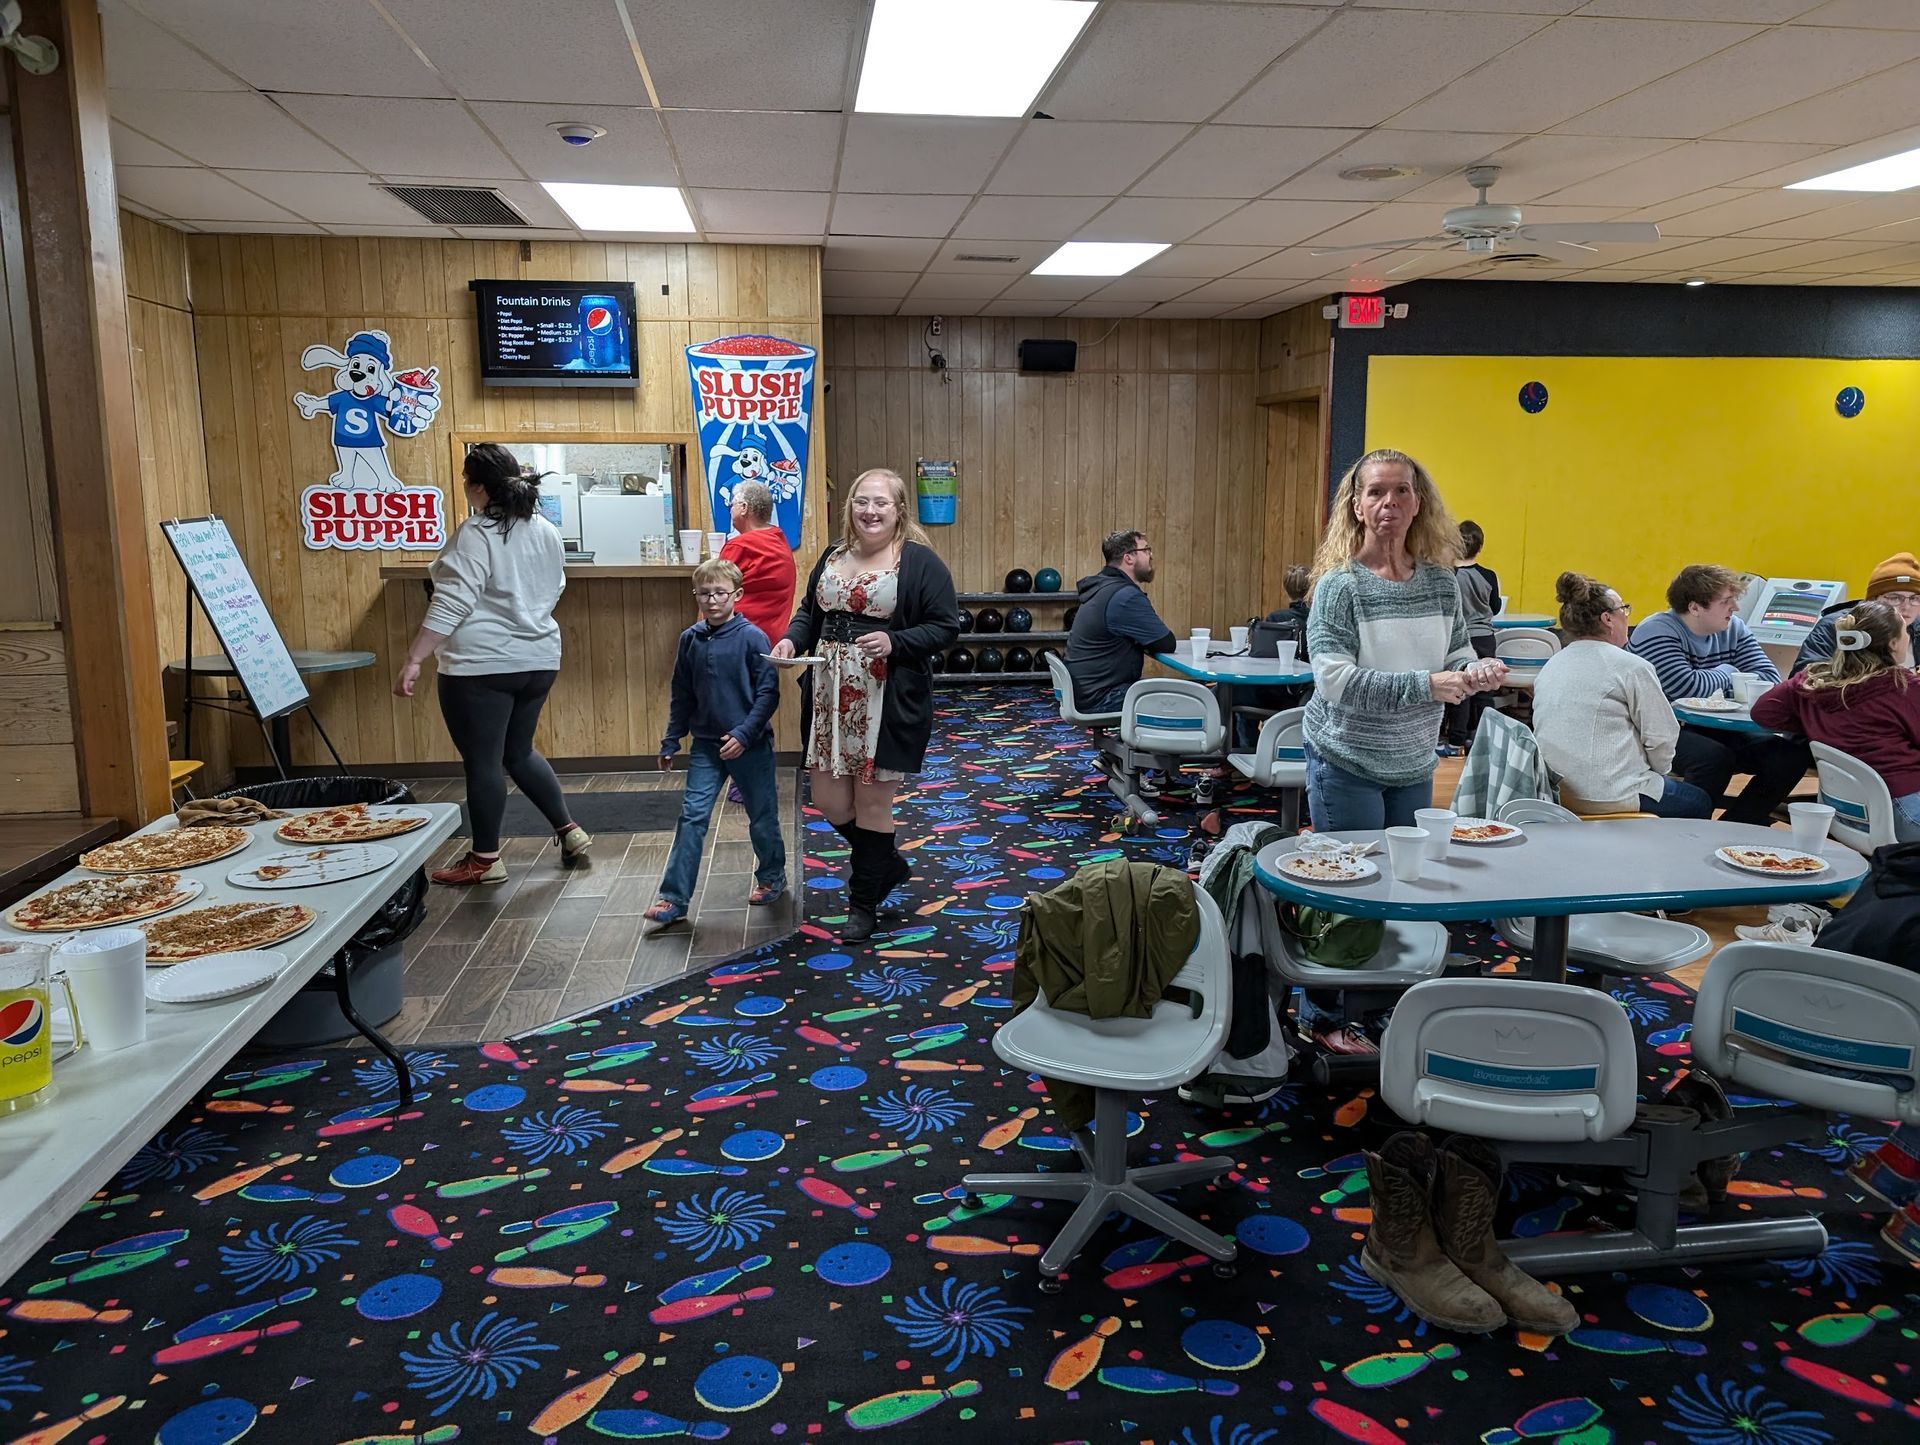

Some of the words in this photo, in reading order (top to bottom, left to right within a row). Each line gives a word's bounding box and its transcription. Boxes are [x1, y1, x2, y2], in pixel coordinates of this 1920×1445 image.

[496, 295, 539, 307] Fountain
[541, 295, 571, 307] Drinks
[1348, 298, 1379, 324] EXIT
[586, 335, 597, 366] pepsi
[699, 369, 803, 399] SLUSH
[344, 408, 369, 434] S
[309, 492, 437, 519] SLUSH
[2, 1047, 42, 1068] pepsi
